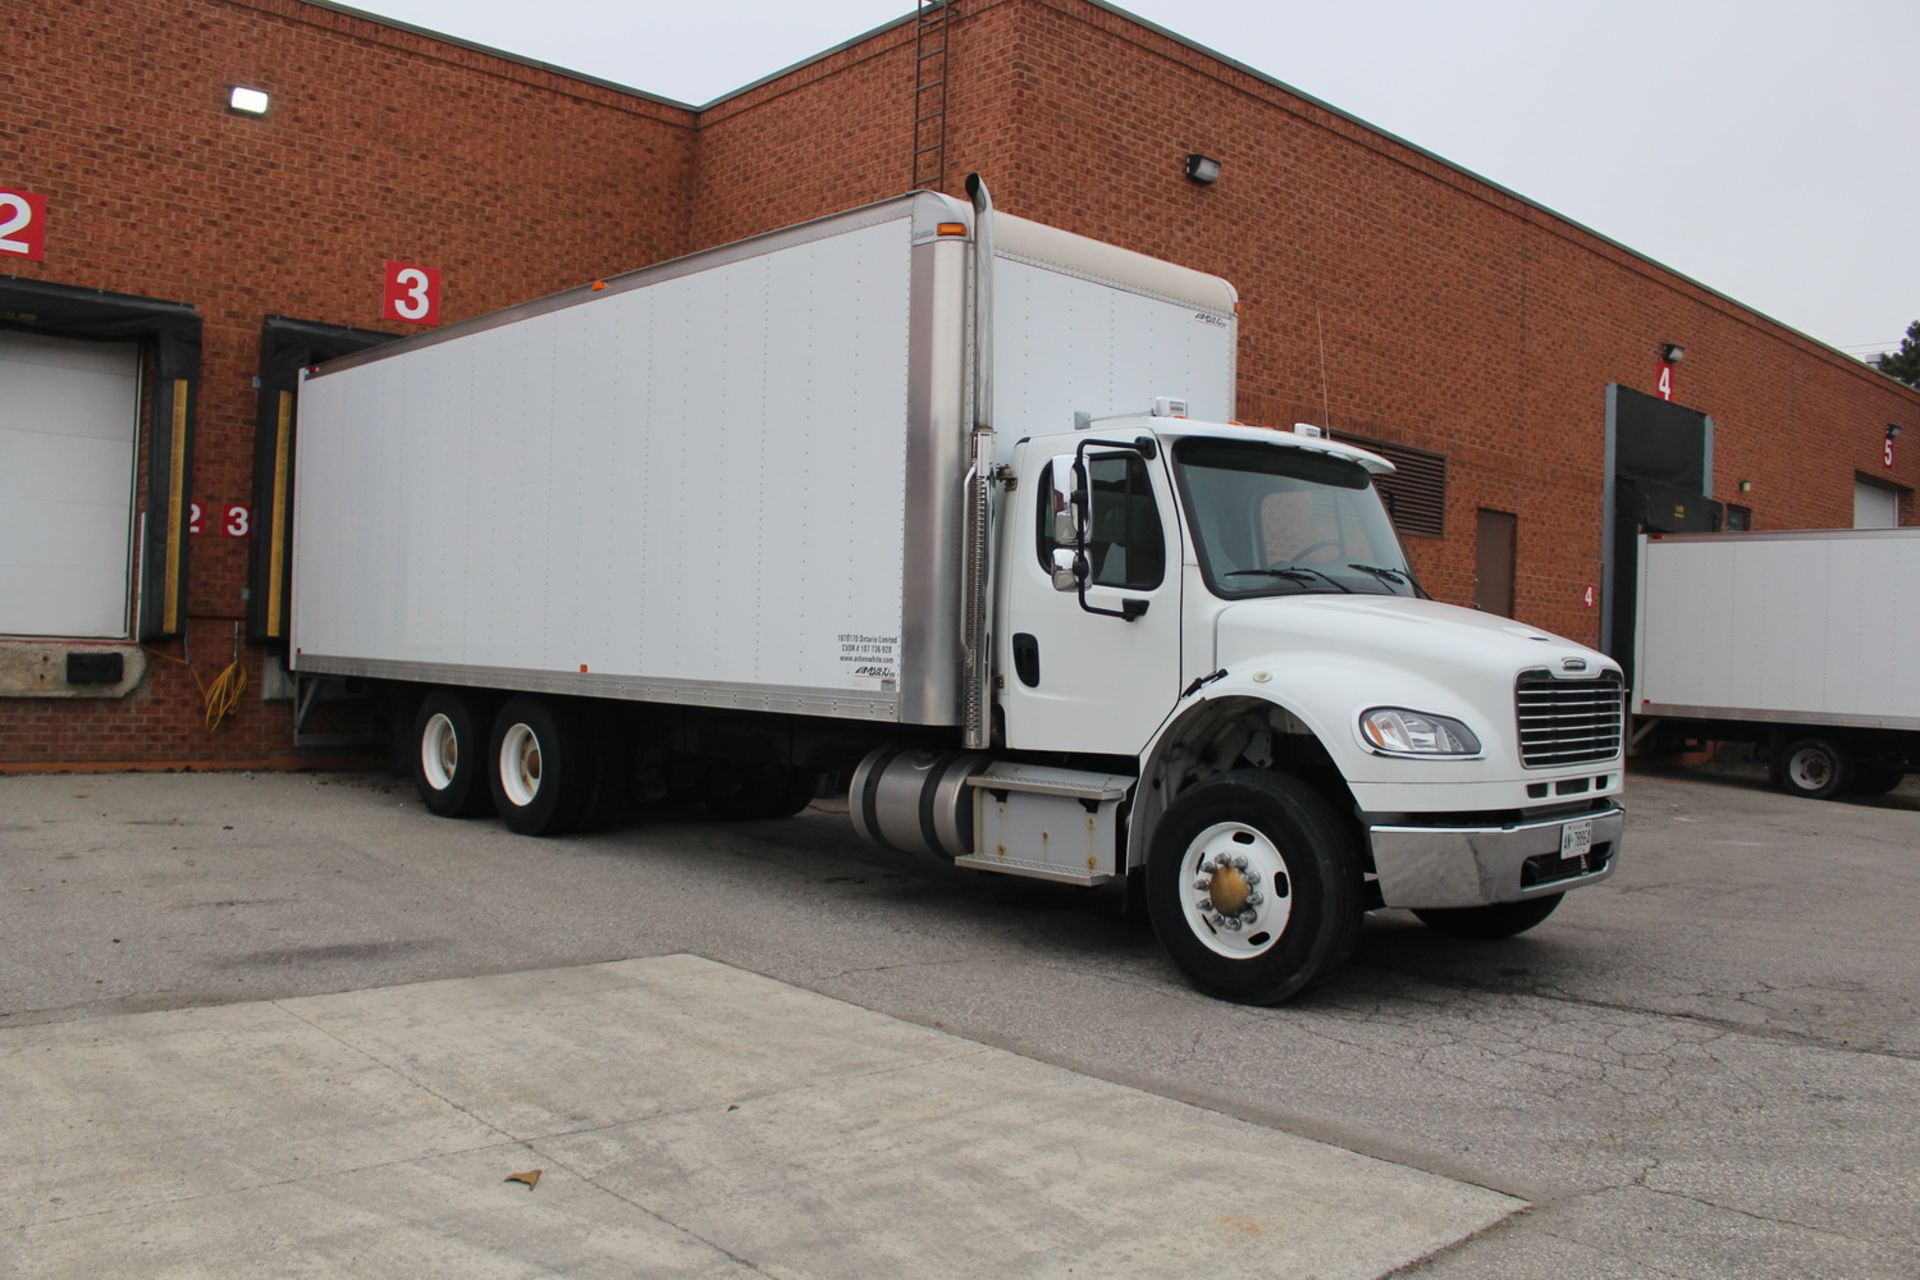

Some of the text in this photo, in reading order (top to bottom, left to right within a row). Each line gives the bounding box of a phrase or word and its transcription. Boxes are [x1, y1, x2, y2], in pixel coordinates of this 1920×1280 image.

[0, 192, 32, 254] 2
[395, 268, 430, 320] 3
[1659, 367, 1671, 401] 4
[1884, 439, 1893, 466] 5
[227, 506, 249, 536] 3
[1585, 586, 1593, 606] 4
[879, 635, 898, 644] Limited
